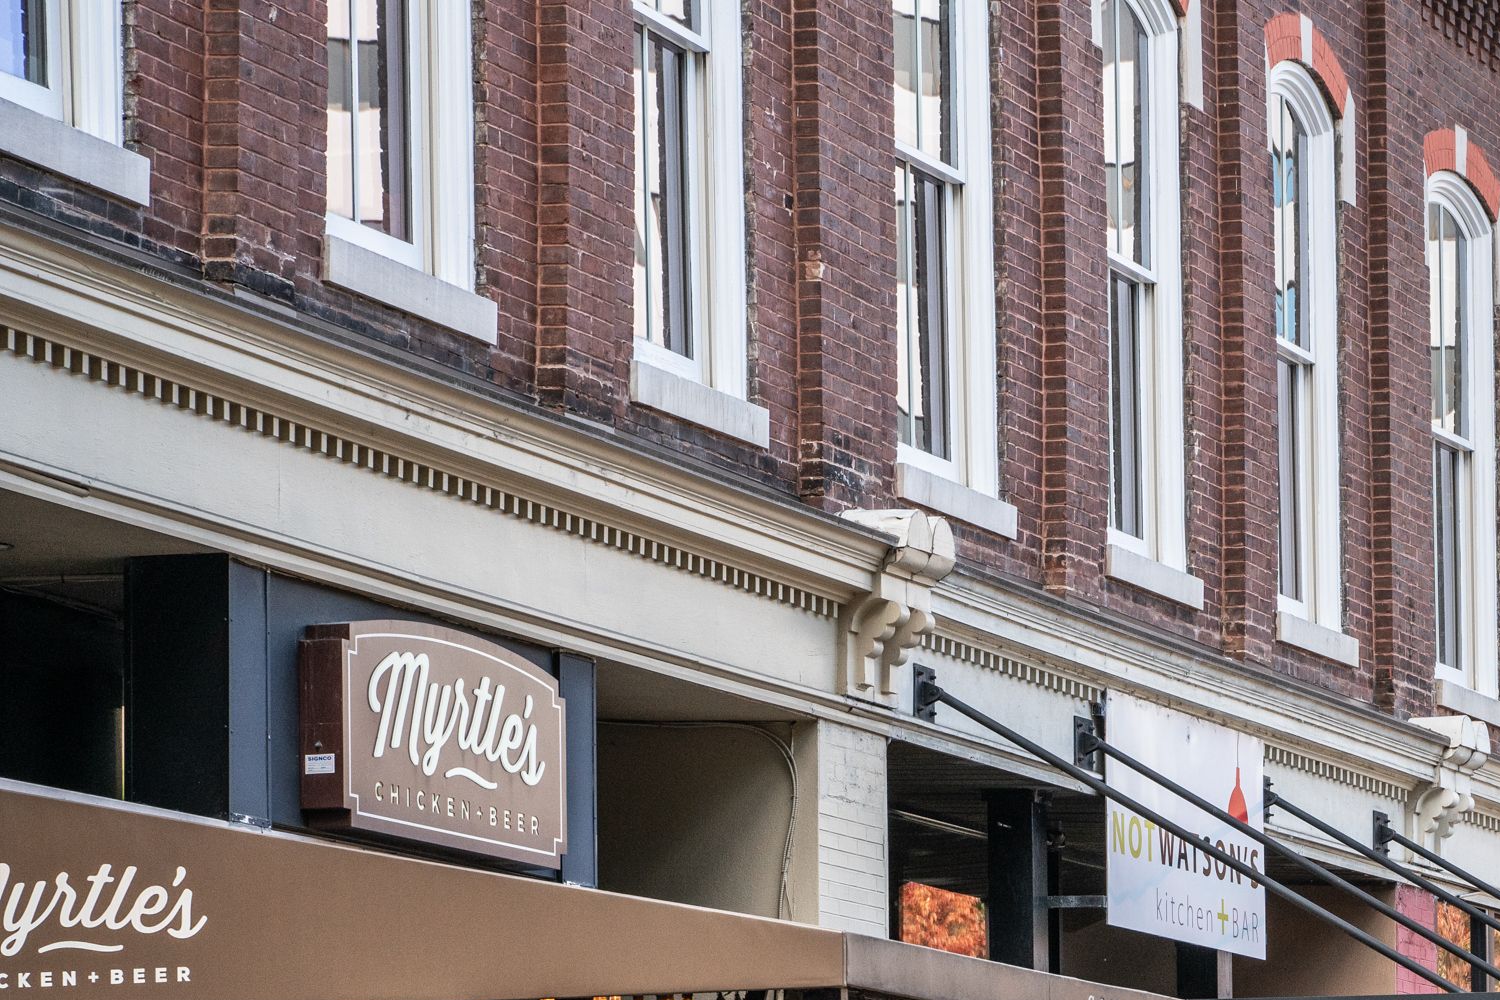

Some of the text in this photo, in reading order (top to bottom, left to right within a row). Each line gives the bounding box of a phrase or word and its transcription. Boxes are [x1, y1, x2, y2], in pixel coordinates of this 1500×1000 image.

[369, 650, 545, 786] Myrtle's
[1156, 888, 1214, 933] kitchen
[1232, 907, 1260, 943] BAR
[0, 970, 77, 989] CKEN
[110, 966, 191, 985] BEER
